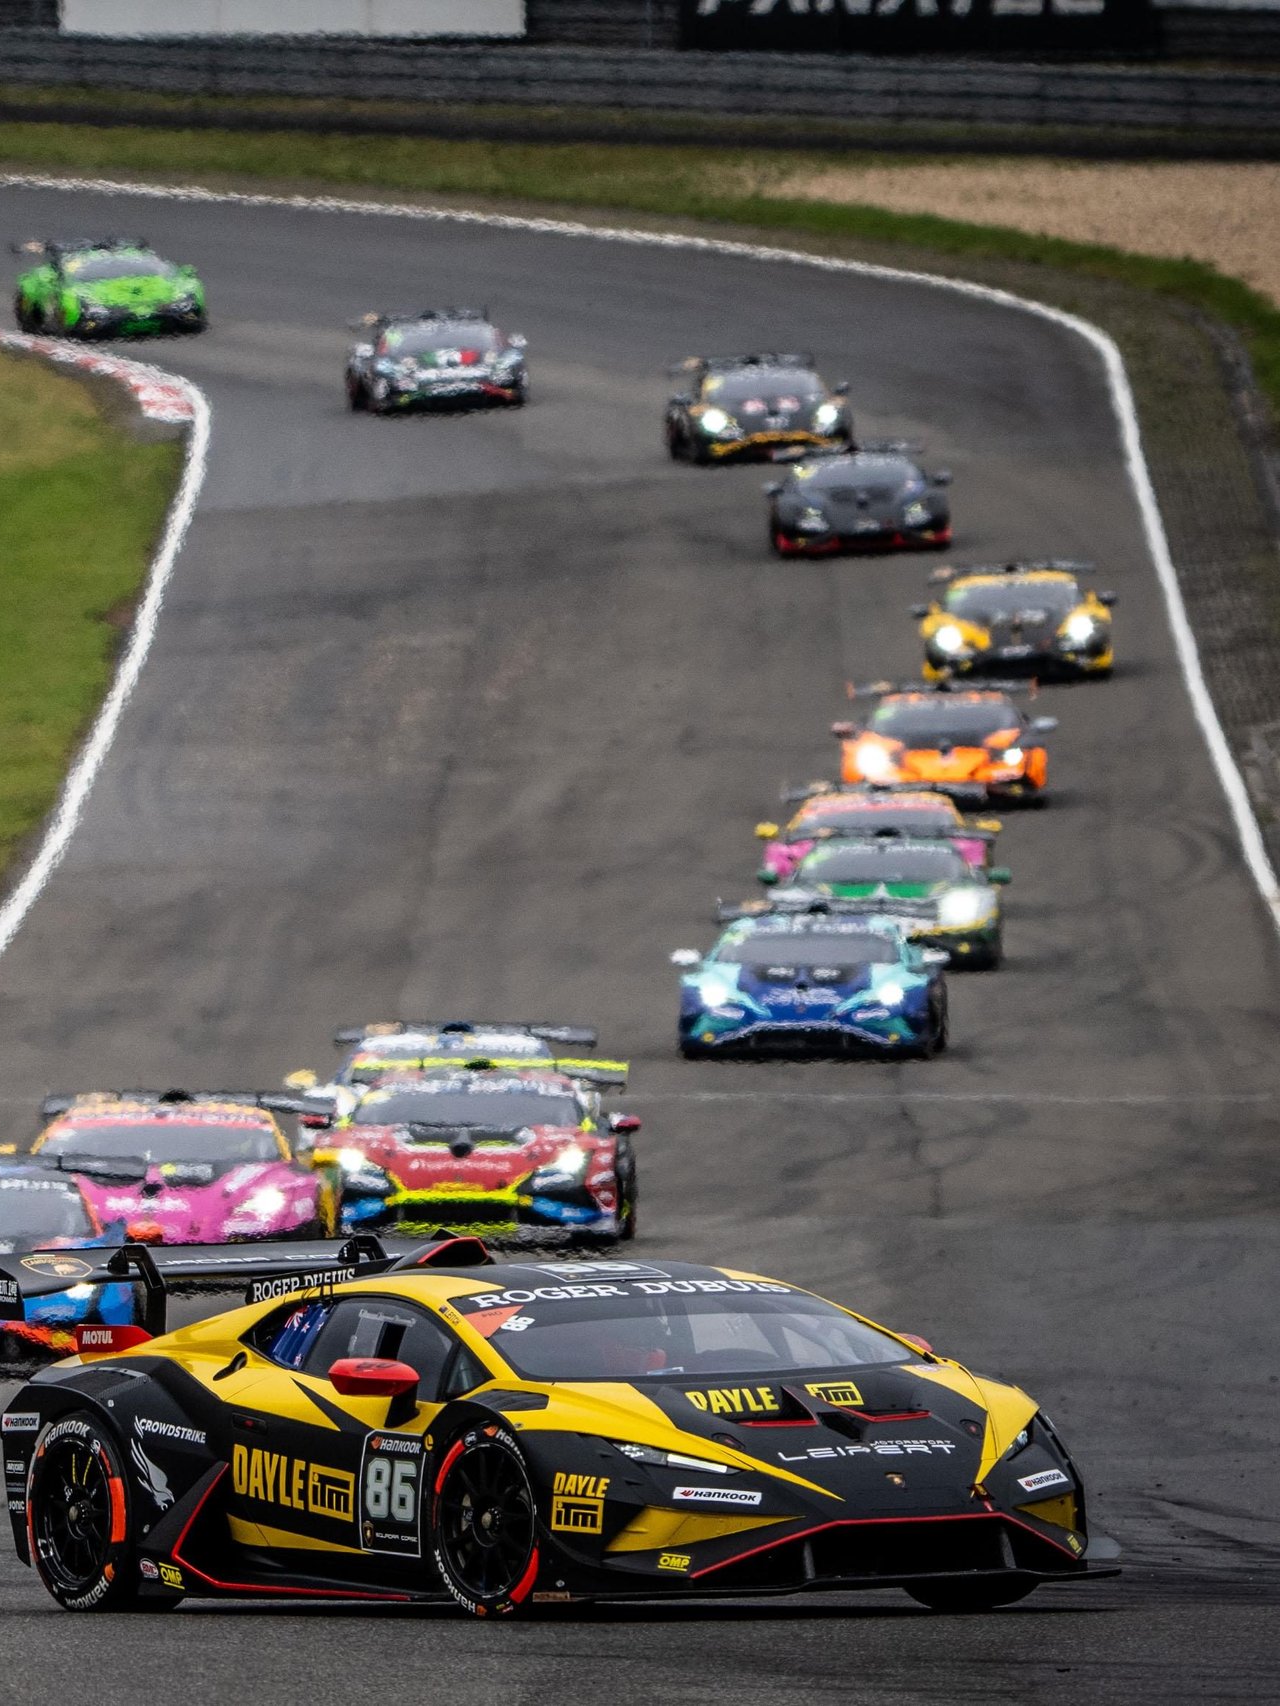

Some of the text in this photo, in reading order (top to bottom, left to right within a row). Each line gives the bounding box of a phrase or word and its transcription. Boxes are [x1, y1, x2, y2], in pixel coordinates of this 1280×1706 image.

[252, 1275, 300, 1303] ROGER
[470, 1280, 792, 1308] ROGER DUBUIS
[500, 1314, 536, 1332] 86
[81, 1330, 113, 1345] MOTUL
[685, 1387, 780, 1414] DAYLE
[139, 1418, 207, 1444] CROWDSTRIKE
[233, 1443, 307, 1511] DAYLE
[366, 1457, 418, 1523] 86
[553, 1472, 610, 1499] DAYLE
[160, 1567, 182, 1585] OMP
[659, 1556, 690, 1569] OMP
